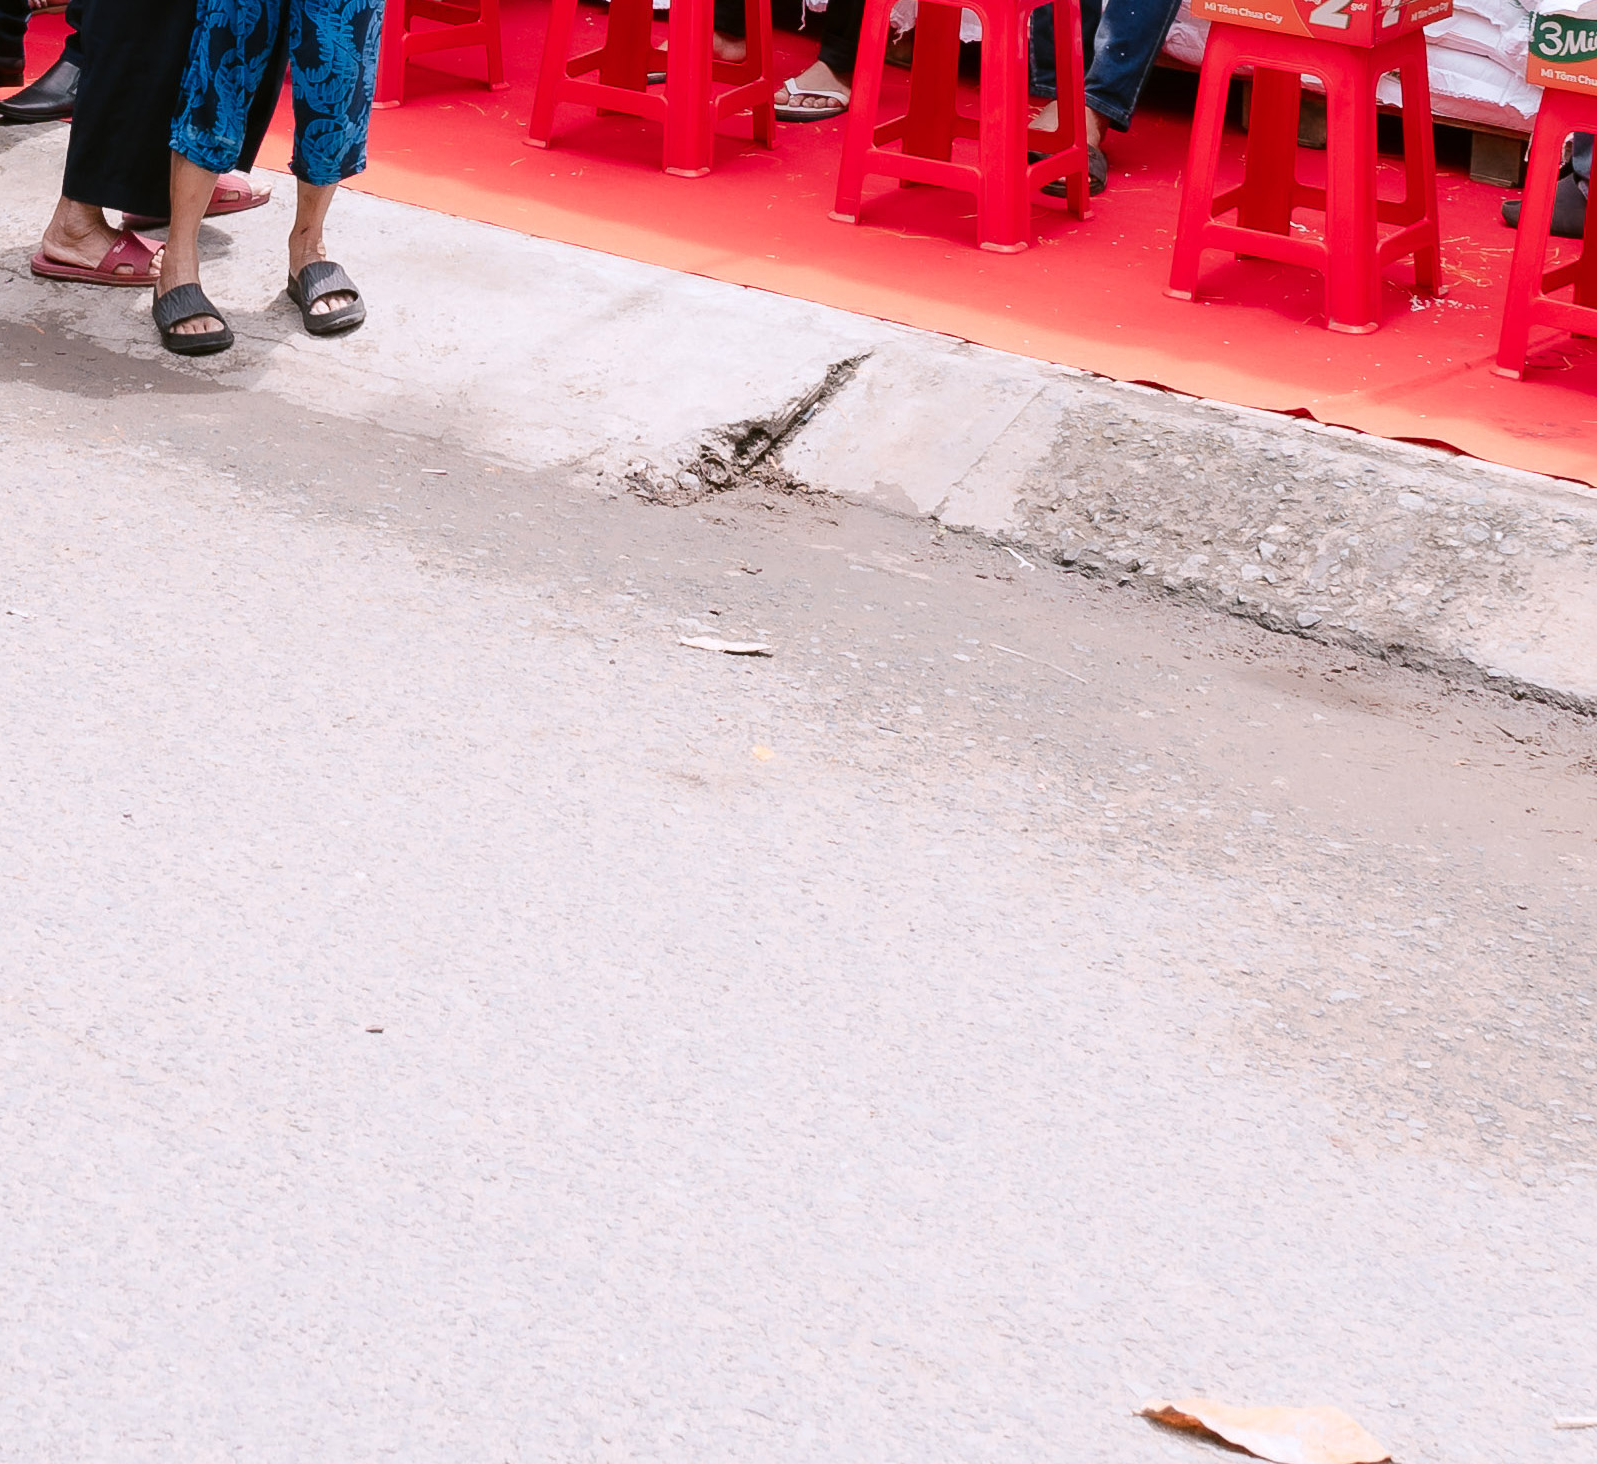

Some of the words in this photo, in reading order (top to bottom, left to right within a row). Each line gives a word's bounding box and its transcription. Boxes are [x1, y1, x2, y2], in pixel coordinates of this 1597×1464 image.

[1350, 1, 1368, 15] gói
[1238, 7, 1262, 22] Chua
[1263, 11, 1283, 26] Cay
